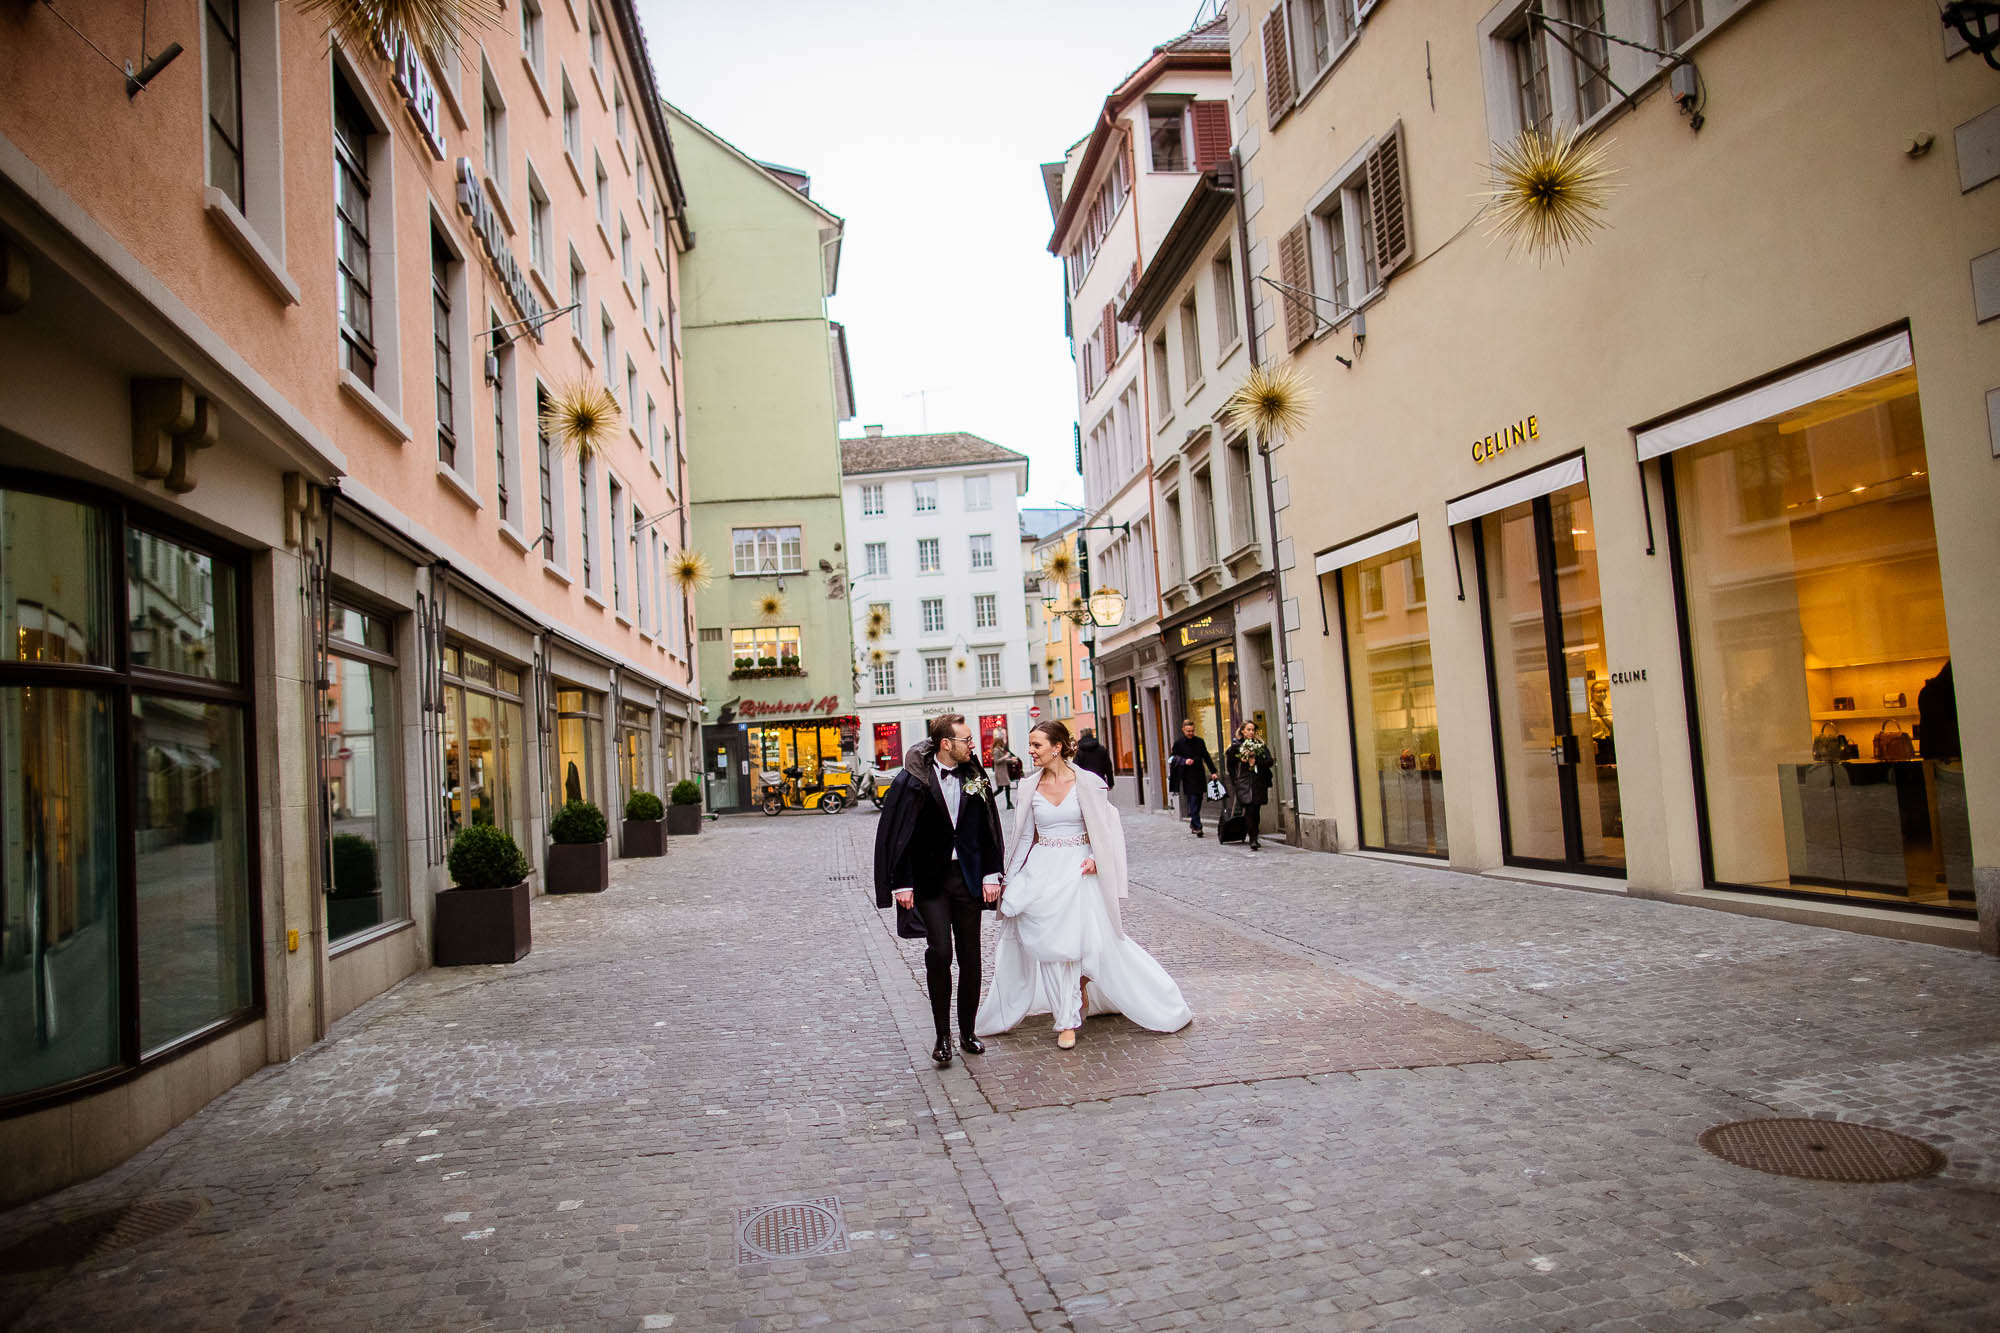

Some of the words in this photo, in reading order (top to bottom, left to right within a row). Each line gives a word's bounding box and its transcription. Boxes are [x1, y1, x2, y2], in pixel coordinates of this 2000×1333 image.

[456, 155, 544, 345] STORCHEN
[1472, 415, 1538, 461] CELINE
[1611, 669, 1647, 684] CELINE
[922, 706, 955, 715] MONCLER
